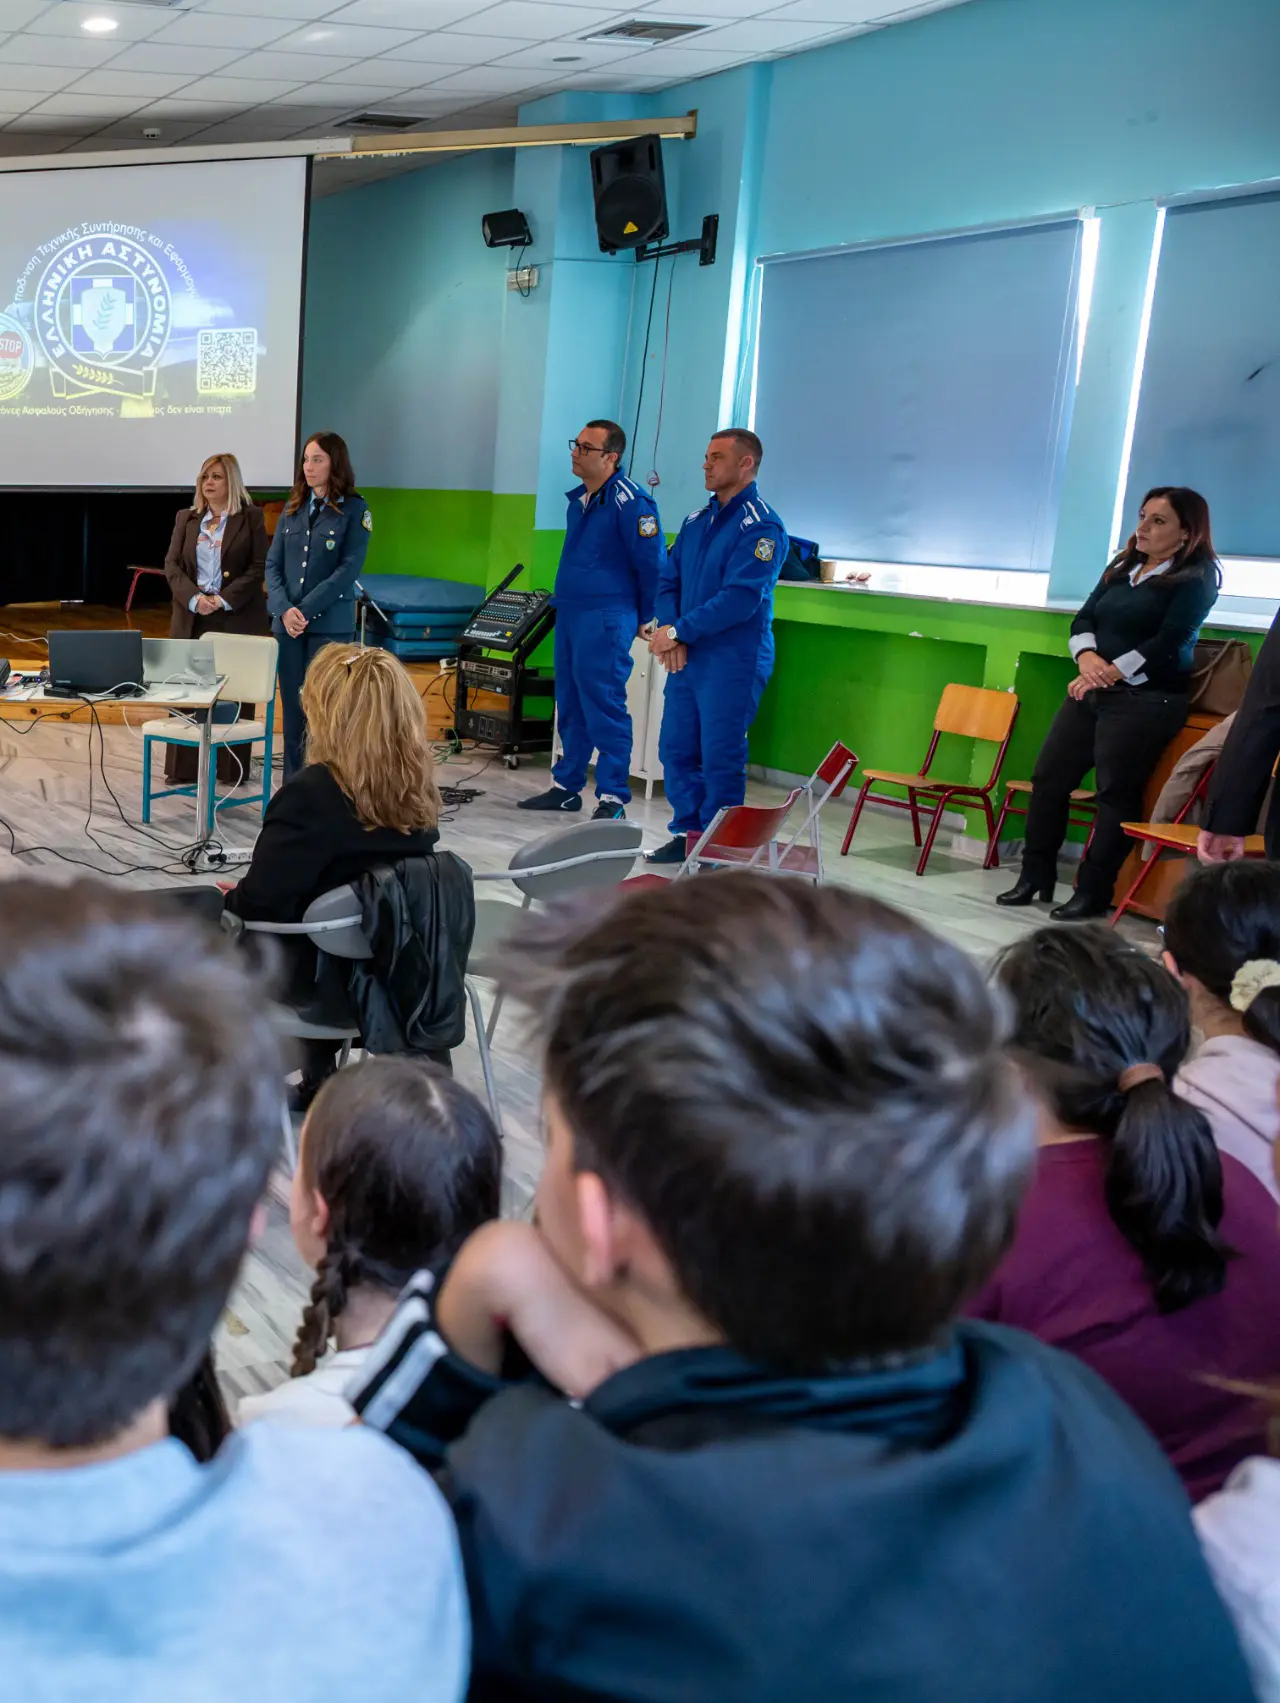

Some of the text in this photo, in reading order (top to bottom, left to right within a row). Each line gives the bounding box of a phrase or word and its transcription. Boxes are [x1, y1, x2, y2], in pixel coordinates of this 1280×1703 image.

[36, 227, 81, 256] Τεχνικής
[81, 220, 147, 242] Συντήρησης
[148, 234, 164, 249] και
[41, 241, 167, 359] ΕΛΛΗΝΙΚΗ ΑΣΤΥΝΟΜΙΑ
[22, 405, 67, 416] Ασφαλούς
[68, 404, 115, 416] Οδήγησης
[167, 404, 182, 415] δεν
